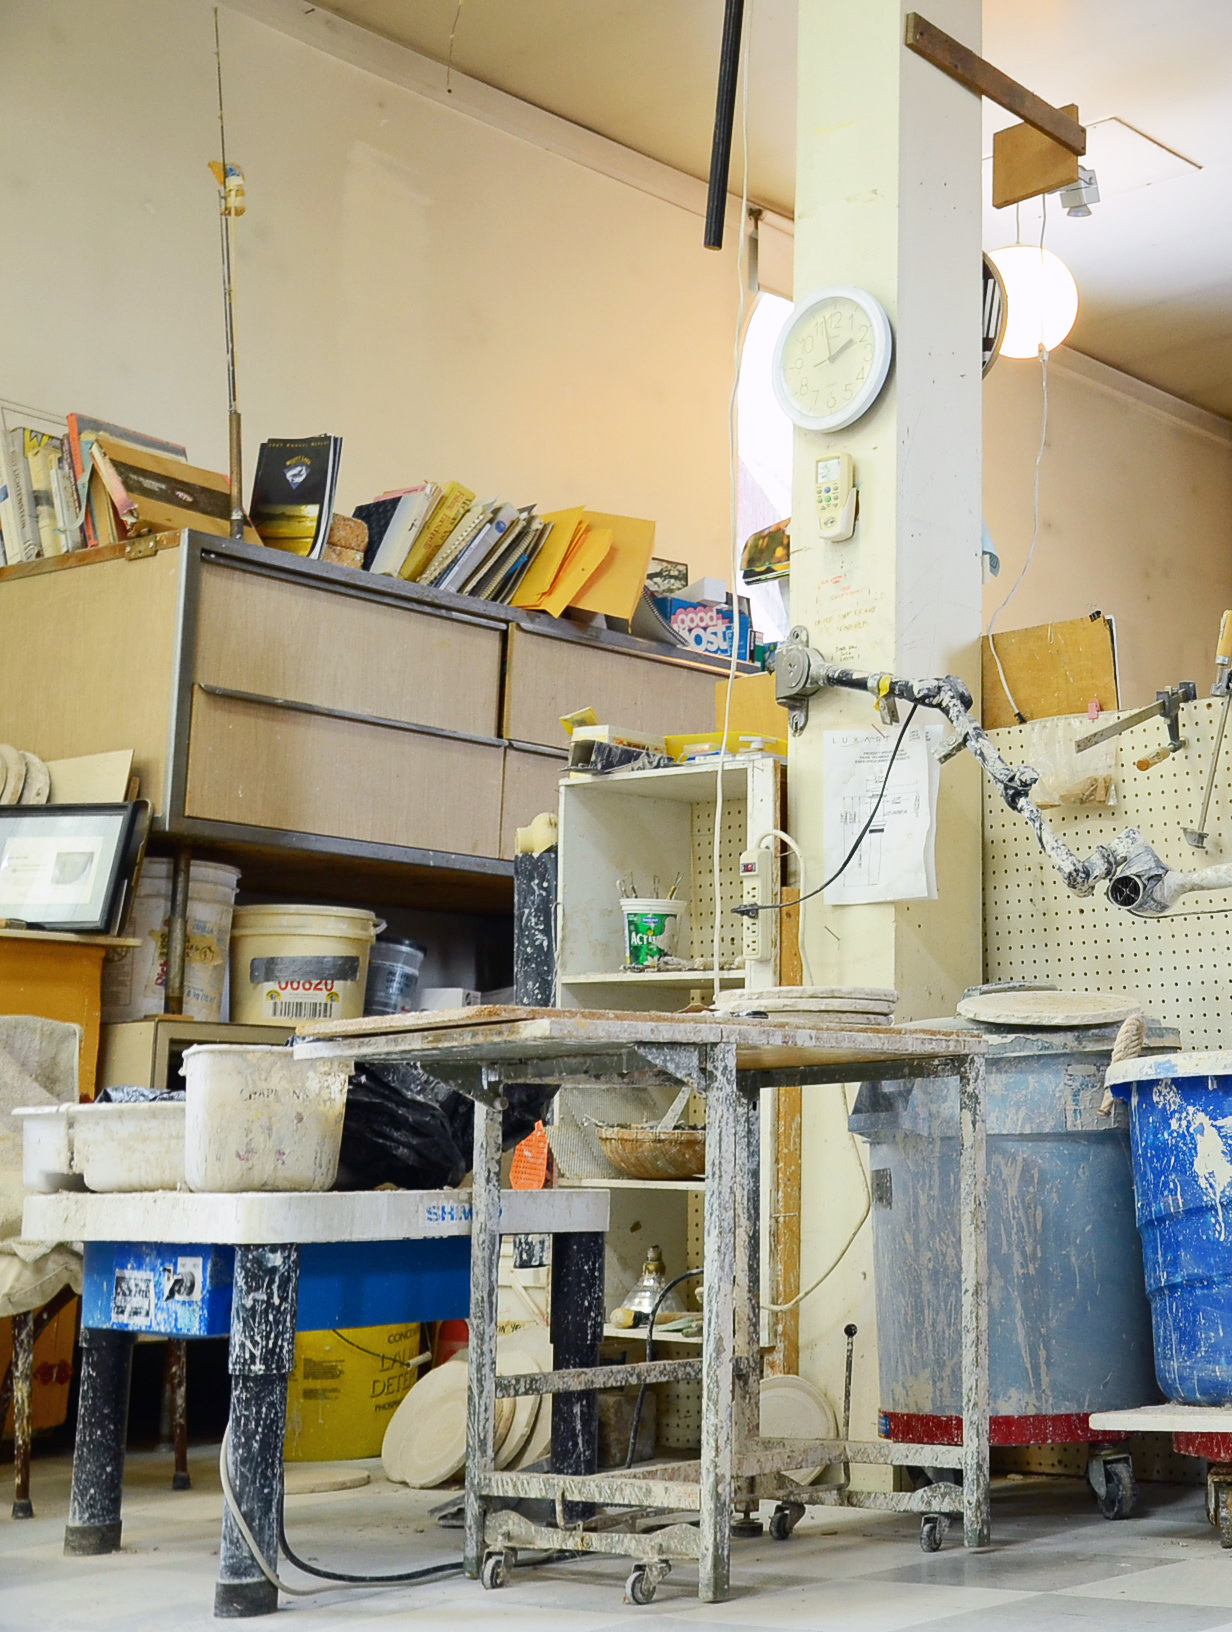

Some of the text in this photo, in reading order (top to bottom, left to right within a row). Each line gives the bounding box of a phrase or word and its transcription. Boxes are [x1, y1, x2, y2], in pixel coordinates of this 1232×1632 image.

[827, 312, 843, 330] 12
[859, 325, 869, 343] 2
[864, 343, 873, 362] 3
[856, 367, 865, 381] 4
[800, 376, 809, 396] 8
[842, 383, 854, 401] 5
[677, 606, 717, 632] good
